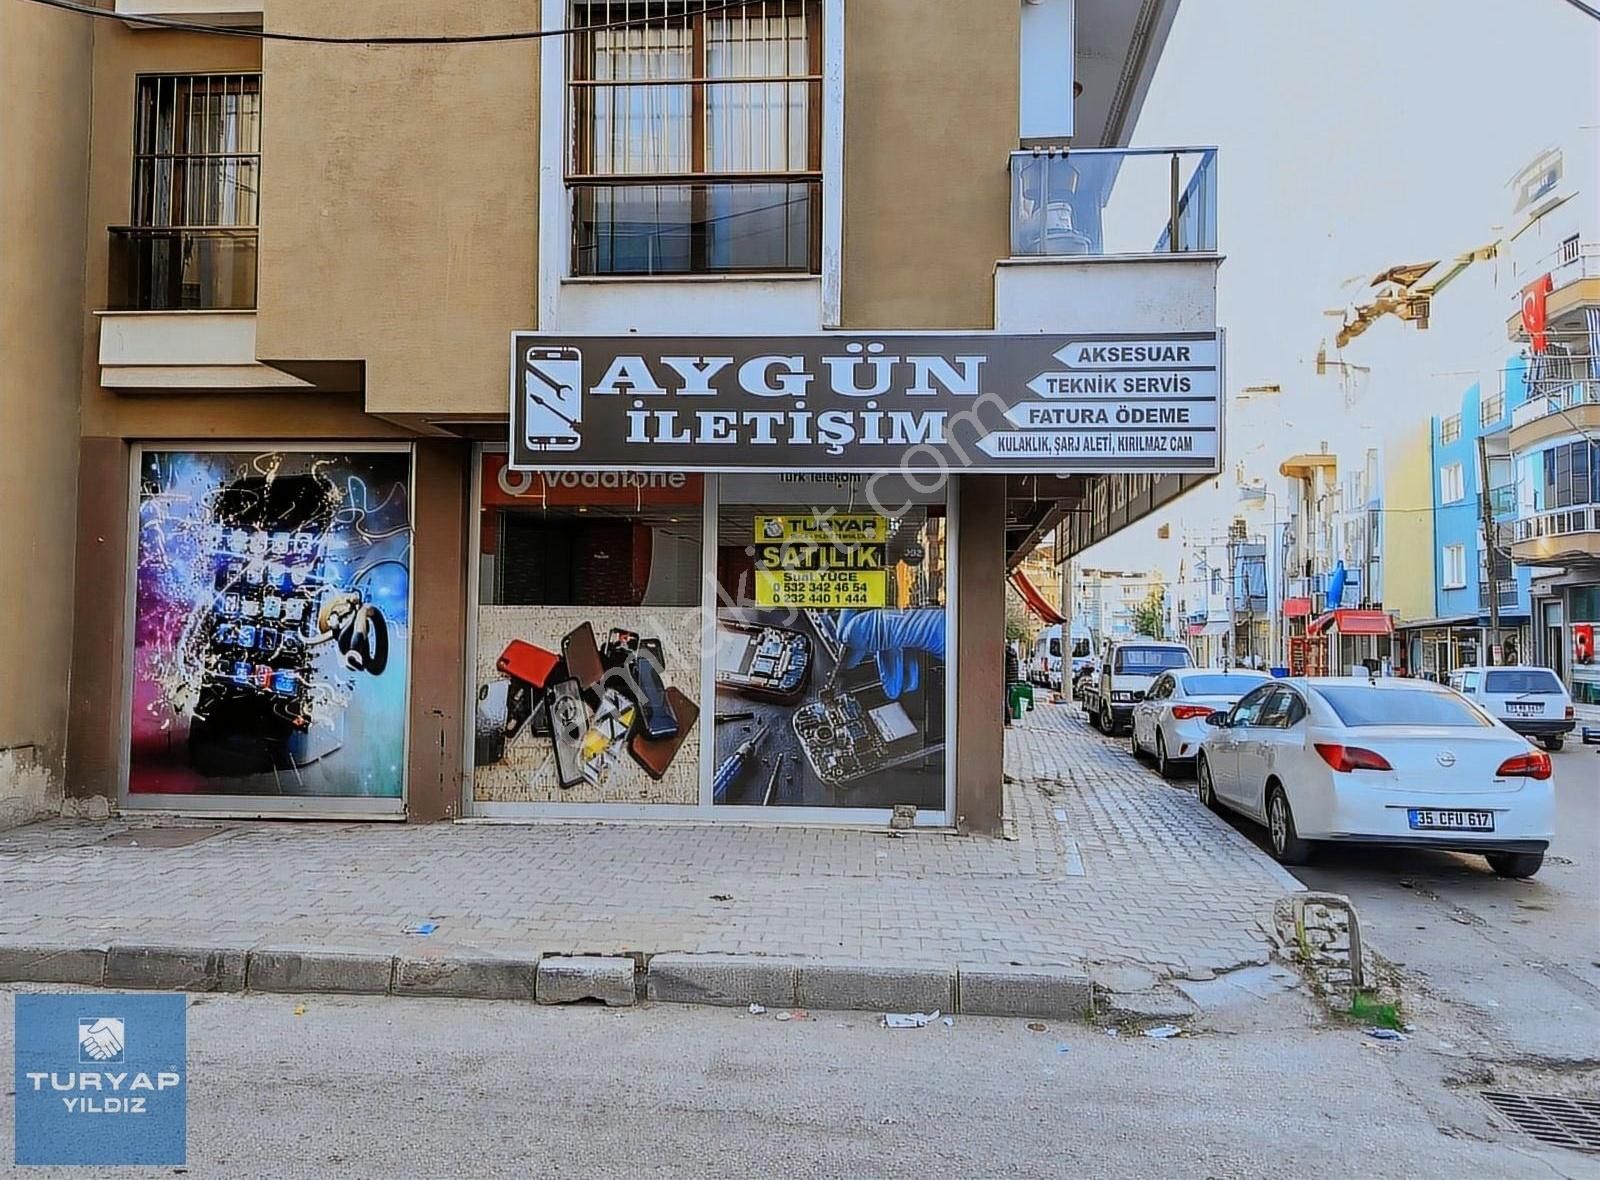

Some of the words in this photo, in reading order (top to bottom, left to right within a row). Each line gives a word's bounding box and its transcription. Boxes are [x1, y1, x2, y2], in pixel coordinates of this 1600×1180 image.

[1077, 346, 1191, 363] AKSESUAR
[590, 343, 988, 396] AYGÜN
[1046, 374, 1117, 393] TEKNİK
[1123, 373, 1191, 392] SERVİS
[1029, 408, 1109, 424] FATURA
[1115, 404, 1190, 424] ÖDEME
[626, 400, 949, 454] İLETİŞİM
[998, 436, 1052, 455] KULAKLIK,
[1054, 436, 1080, 455] ŞARJ
[1083, 433, 1115, 455] ALETİ,
[1118, 436, 1167, 452] KIRILMAZ
[1170, 436, 1193, 452] CAM
[545, 470, 686, 488] vodafone
[788, 519, 877, 532] TURYAP
[763, 546, 878, 568] SATILIK
[784, 583, 805, 592] 532
[809, 583, 830, 592] 342
[834, 583, 849, 592] 46
[853, 583, 867, 592] 54
[773, 594, 780, 603] 0
[784, 594, 805, 603] 232
[809, 594, 831, 603] 440
[845, 594, 867, 603] 444
[1418, 812, 1433, 825] 35
[1440, 812, 1463, 826] CFU
[1468, 813, 1489, 826] 617
